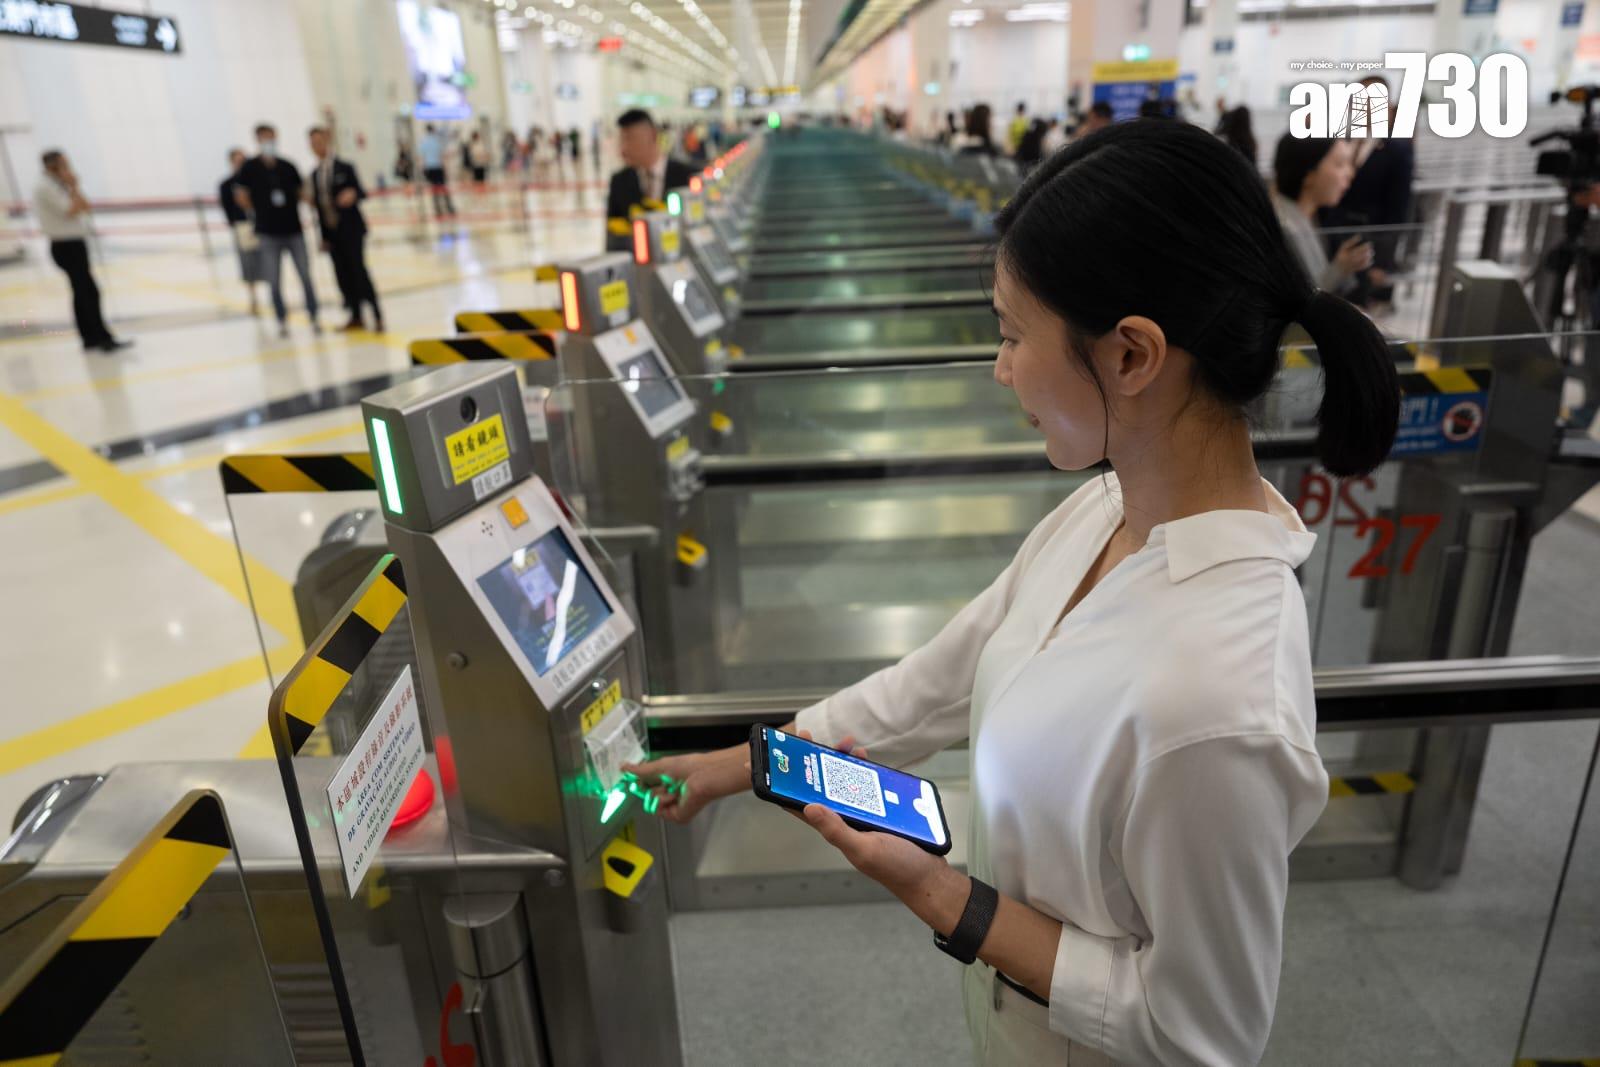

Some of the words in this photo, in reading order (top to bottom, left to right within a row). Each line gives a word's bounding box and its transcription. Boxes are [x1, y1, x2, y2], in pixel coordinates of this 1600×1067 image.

[1346, 514, 1442, 580] 27
[371, 761, 383, 783] COM
[383, 724, 404, 761] SISTEMAS
[347, 825, 356, 841] DE
[356, 778, 383, 826] GRAVAÇÃO
[352, 853, 364, 873] AND
[364, 823, 380, 851] VIDEO
[380, 777, 405, 823] RECORDING
[366, 807, 380, 831] AREA
[380, 782, 393, 804] WITH
[393, 756, 407, 782] AUDIO
